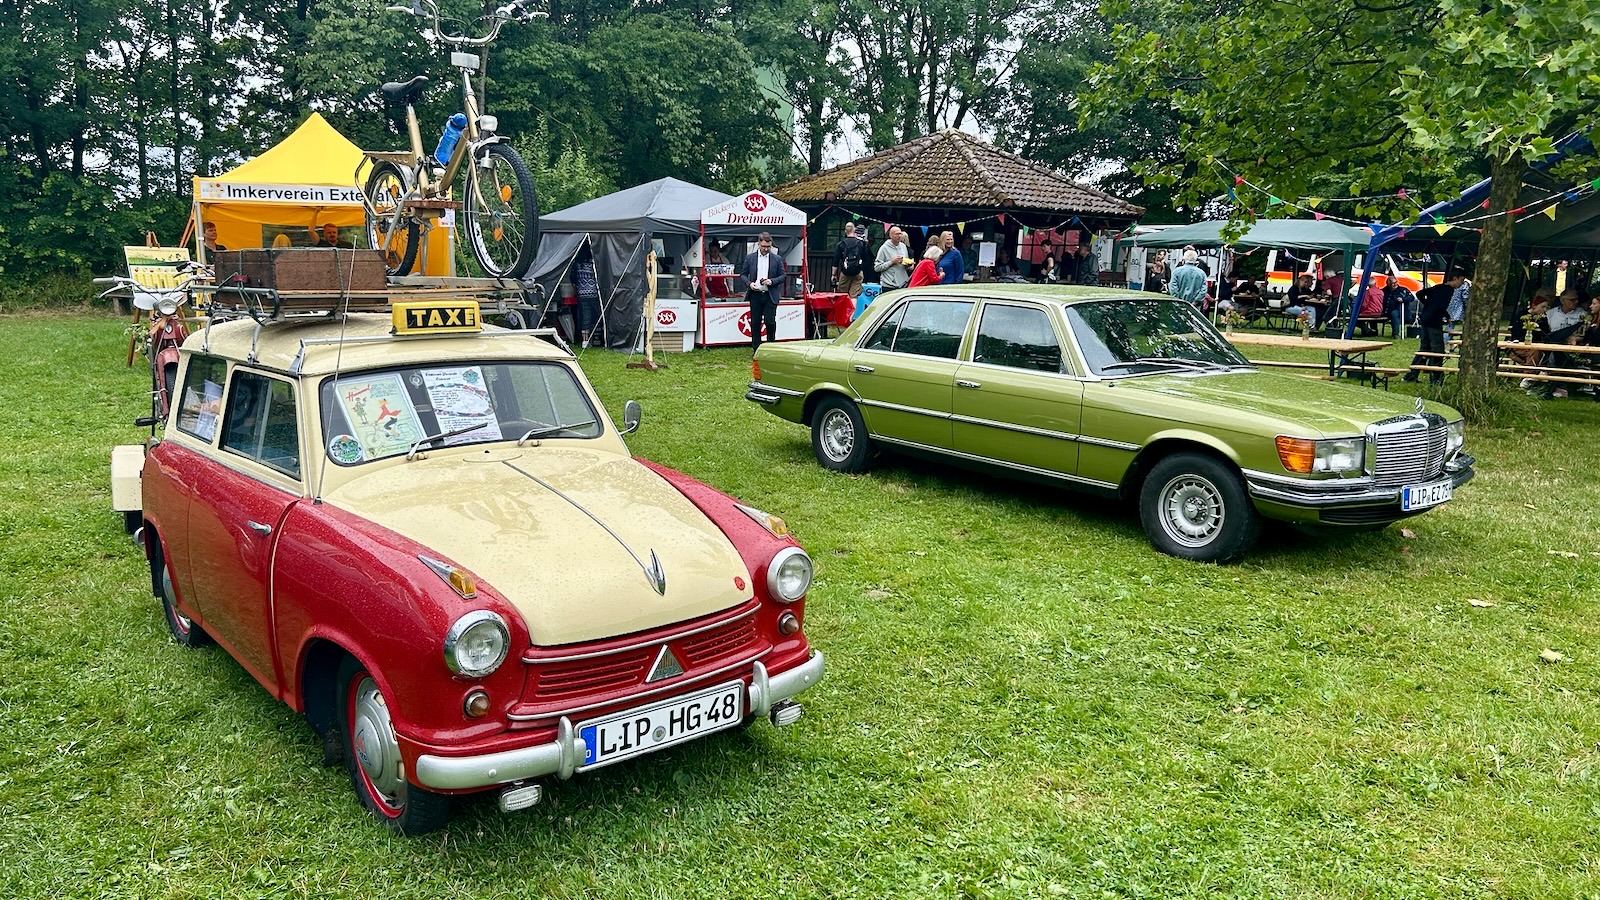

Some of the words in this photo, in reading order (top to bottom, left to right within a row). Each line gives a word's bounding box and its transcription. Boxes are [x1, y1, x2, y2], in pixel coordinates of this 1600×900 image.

[227, 184, 324, 201] Imkerverein
[708, 201, 738, 218] Bäckerei
[726, 212, 784, 224] Dreimann
[770, 199, 805, 220] Konditorei
[411, 308, 475, 327] TAXE
[1411, 488, 1427, 506] LIP
[1431, 485, 1441, 502] EZ
[600, 717, 651, 757] LIP
[669, 702, 702, 737] HG
[707, 693, 736, 723] 48
